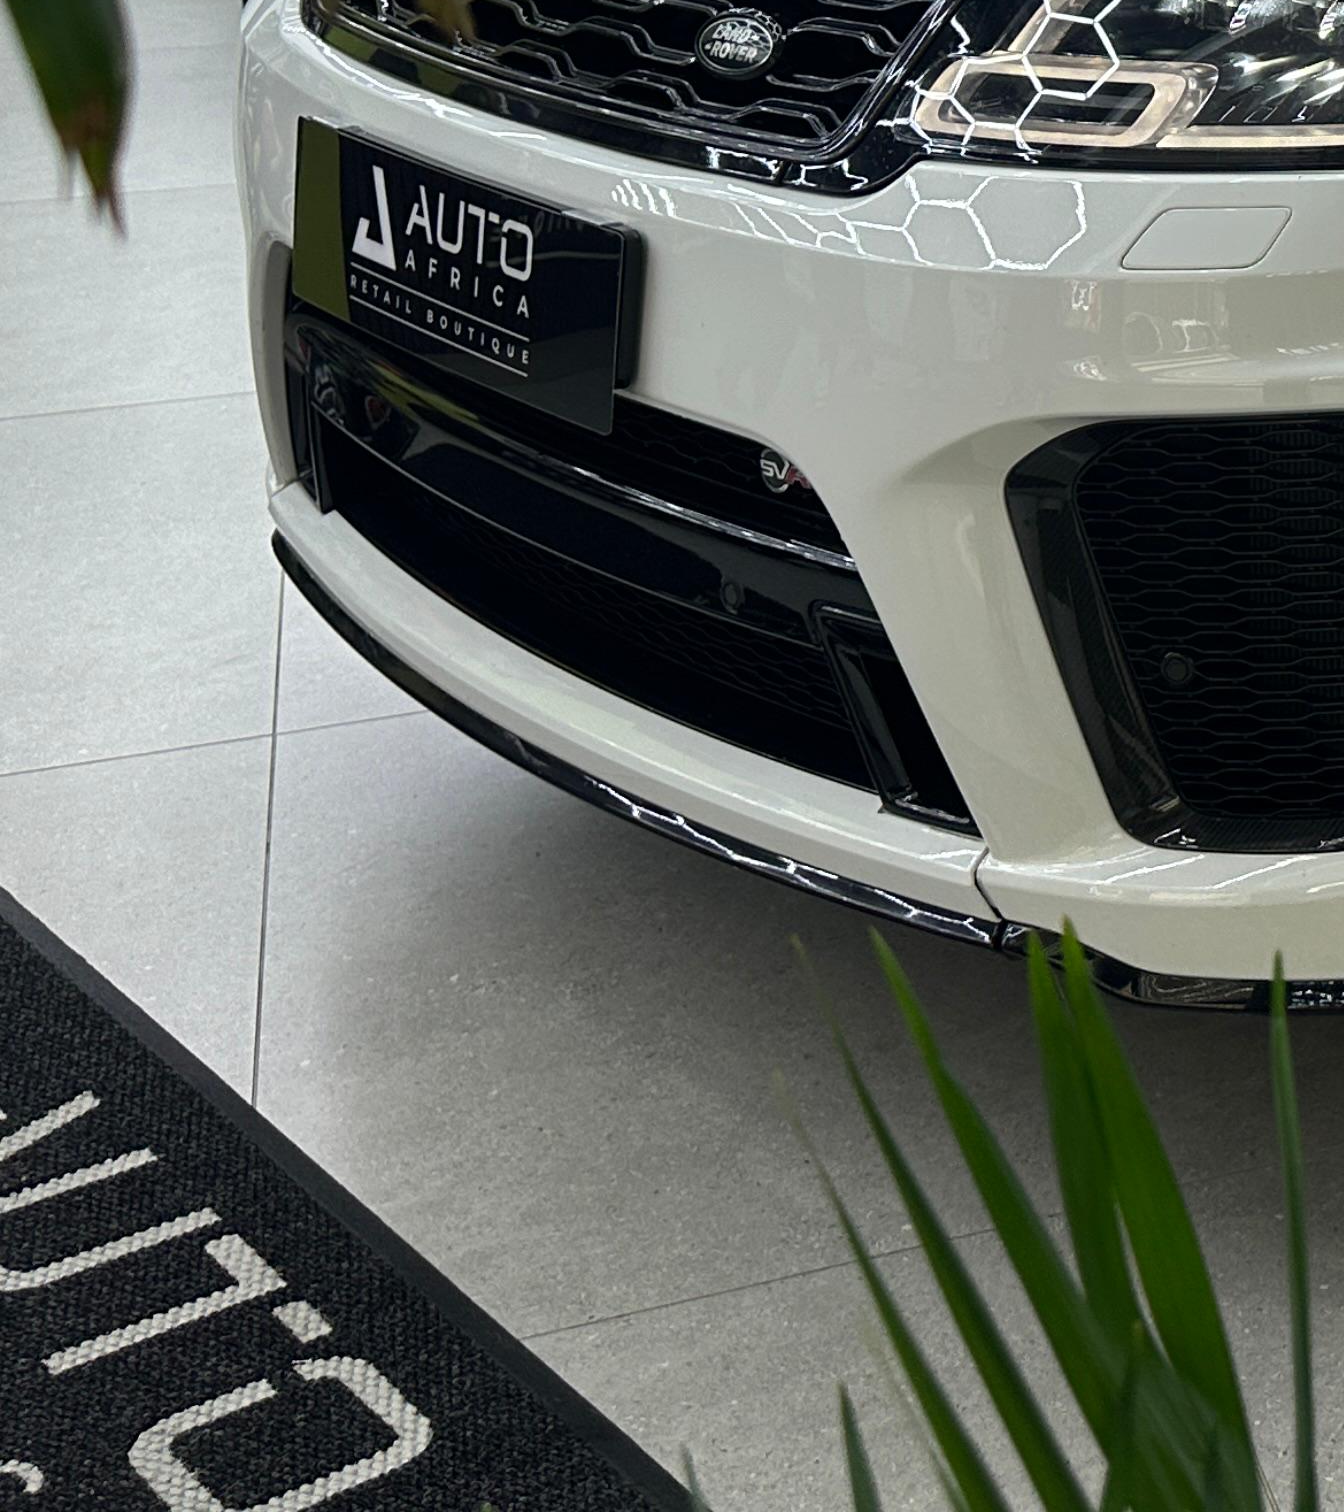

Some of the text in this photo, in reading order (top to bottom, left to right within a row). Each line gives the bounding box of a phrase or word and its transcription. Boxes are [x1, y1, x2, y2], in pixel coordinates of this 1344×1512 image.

[709, 40, 759, 64] ROVER
[405, 185, 534, 282] AUTO
[350, 274, 529, 365] RETAIL BOUTIQUE
[404, 248, 530, 319] AFRICA
